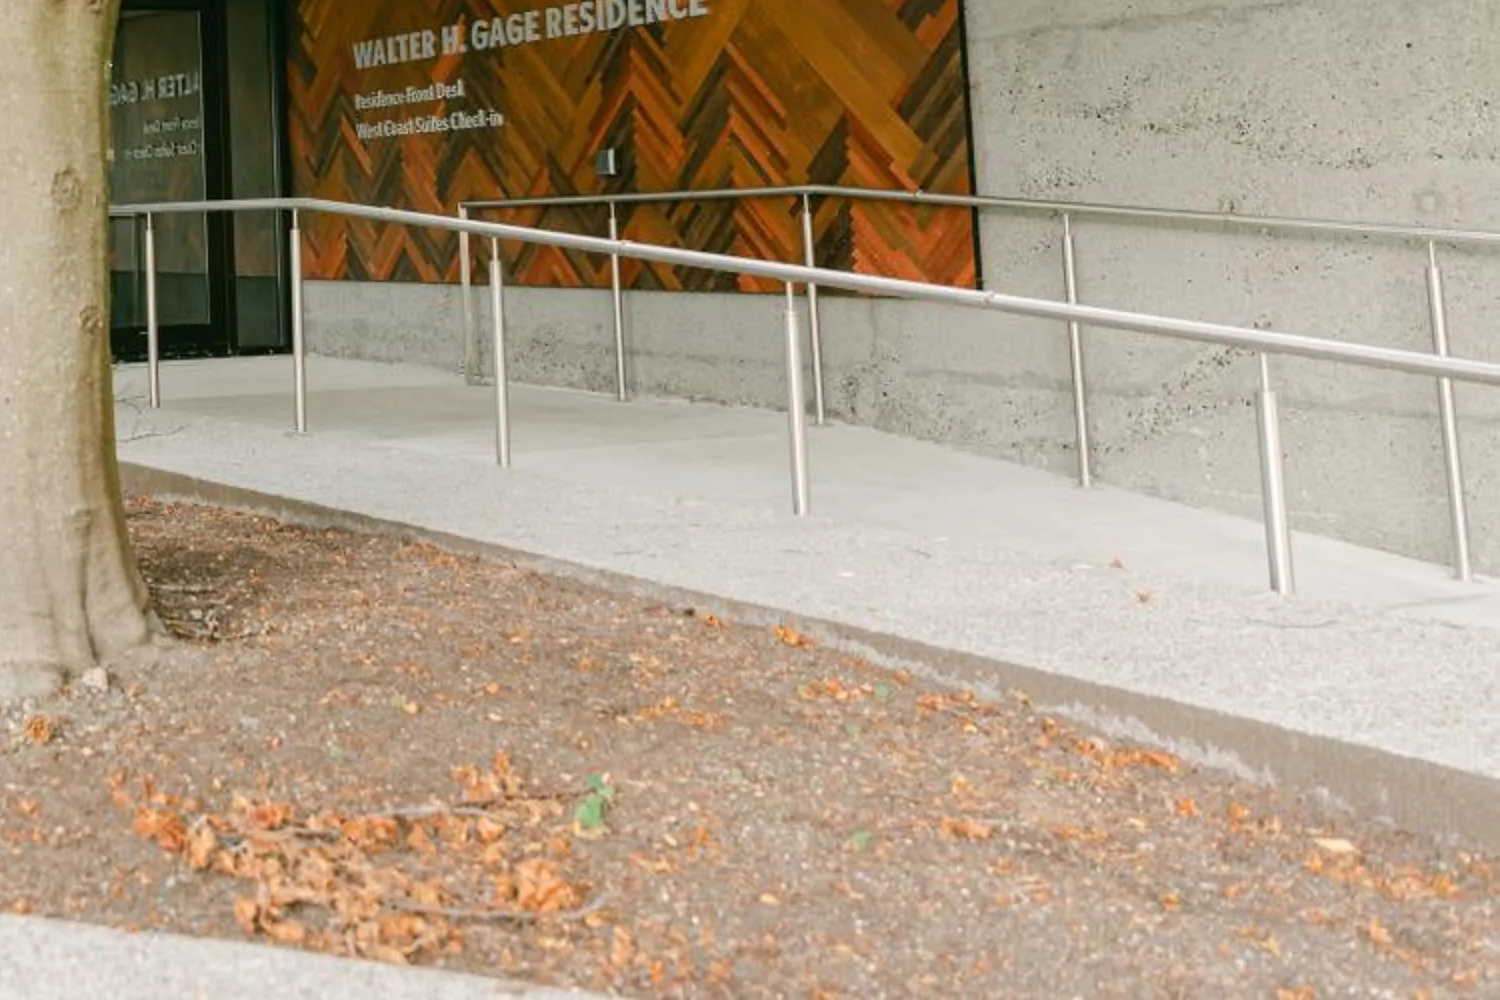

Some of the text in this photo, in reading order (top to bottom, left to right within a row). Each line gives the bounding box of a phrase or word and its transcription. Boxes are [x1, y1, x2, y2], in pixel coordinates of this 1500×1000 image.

[353, 30, 435, 69] WALTER
[441, 24, 466, 55] H.
[471, 11, 541, 51] GAGE
[435, 78, 465, 99] Desk
[356, 108, 504, 139] West Coast Suites Check-in
